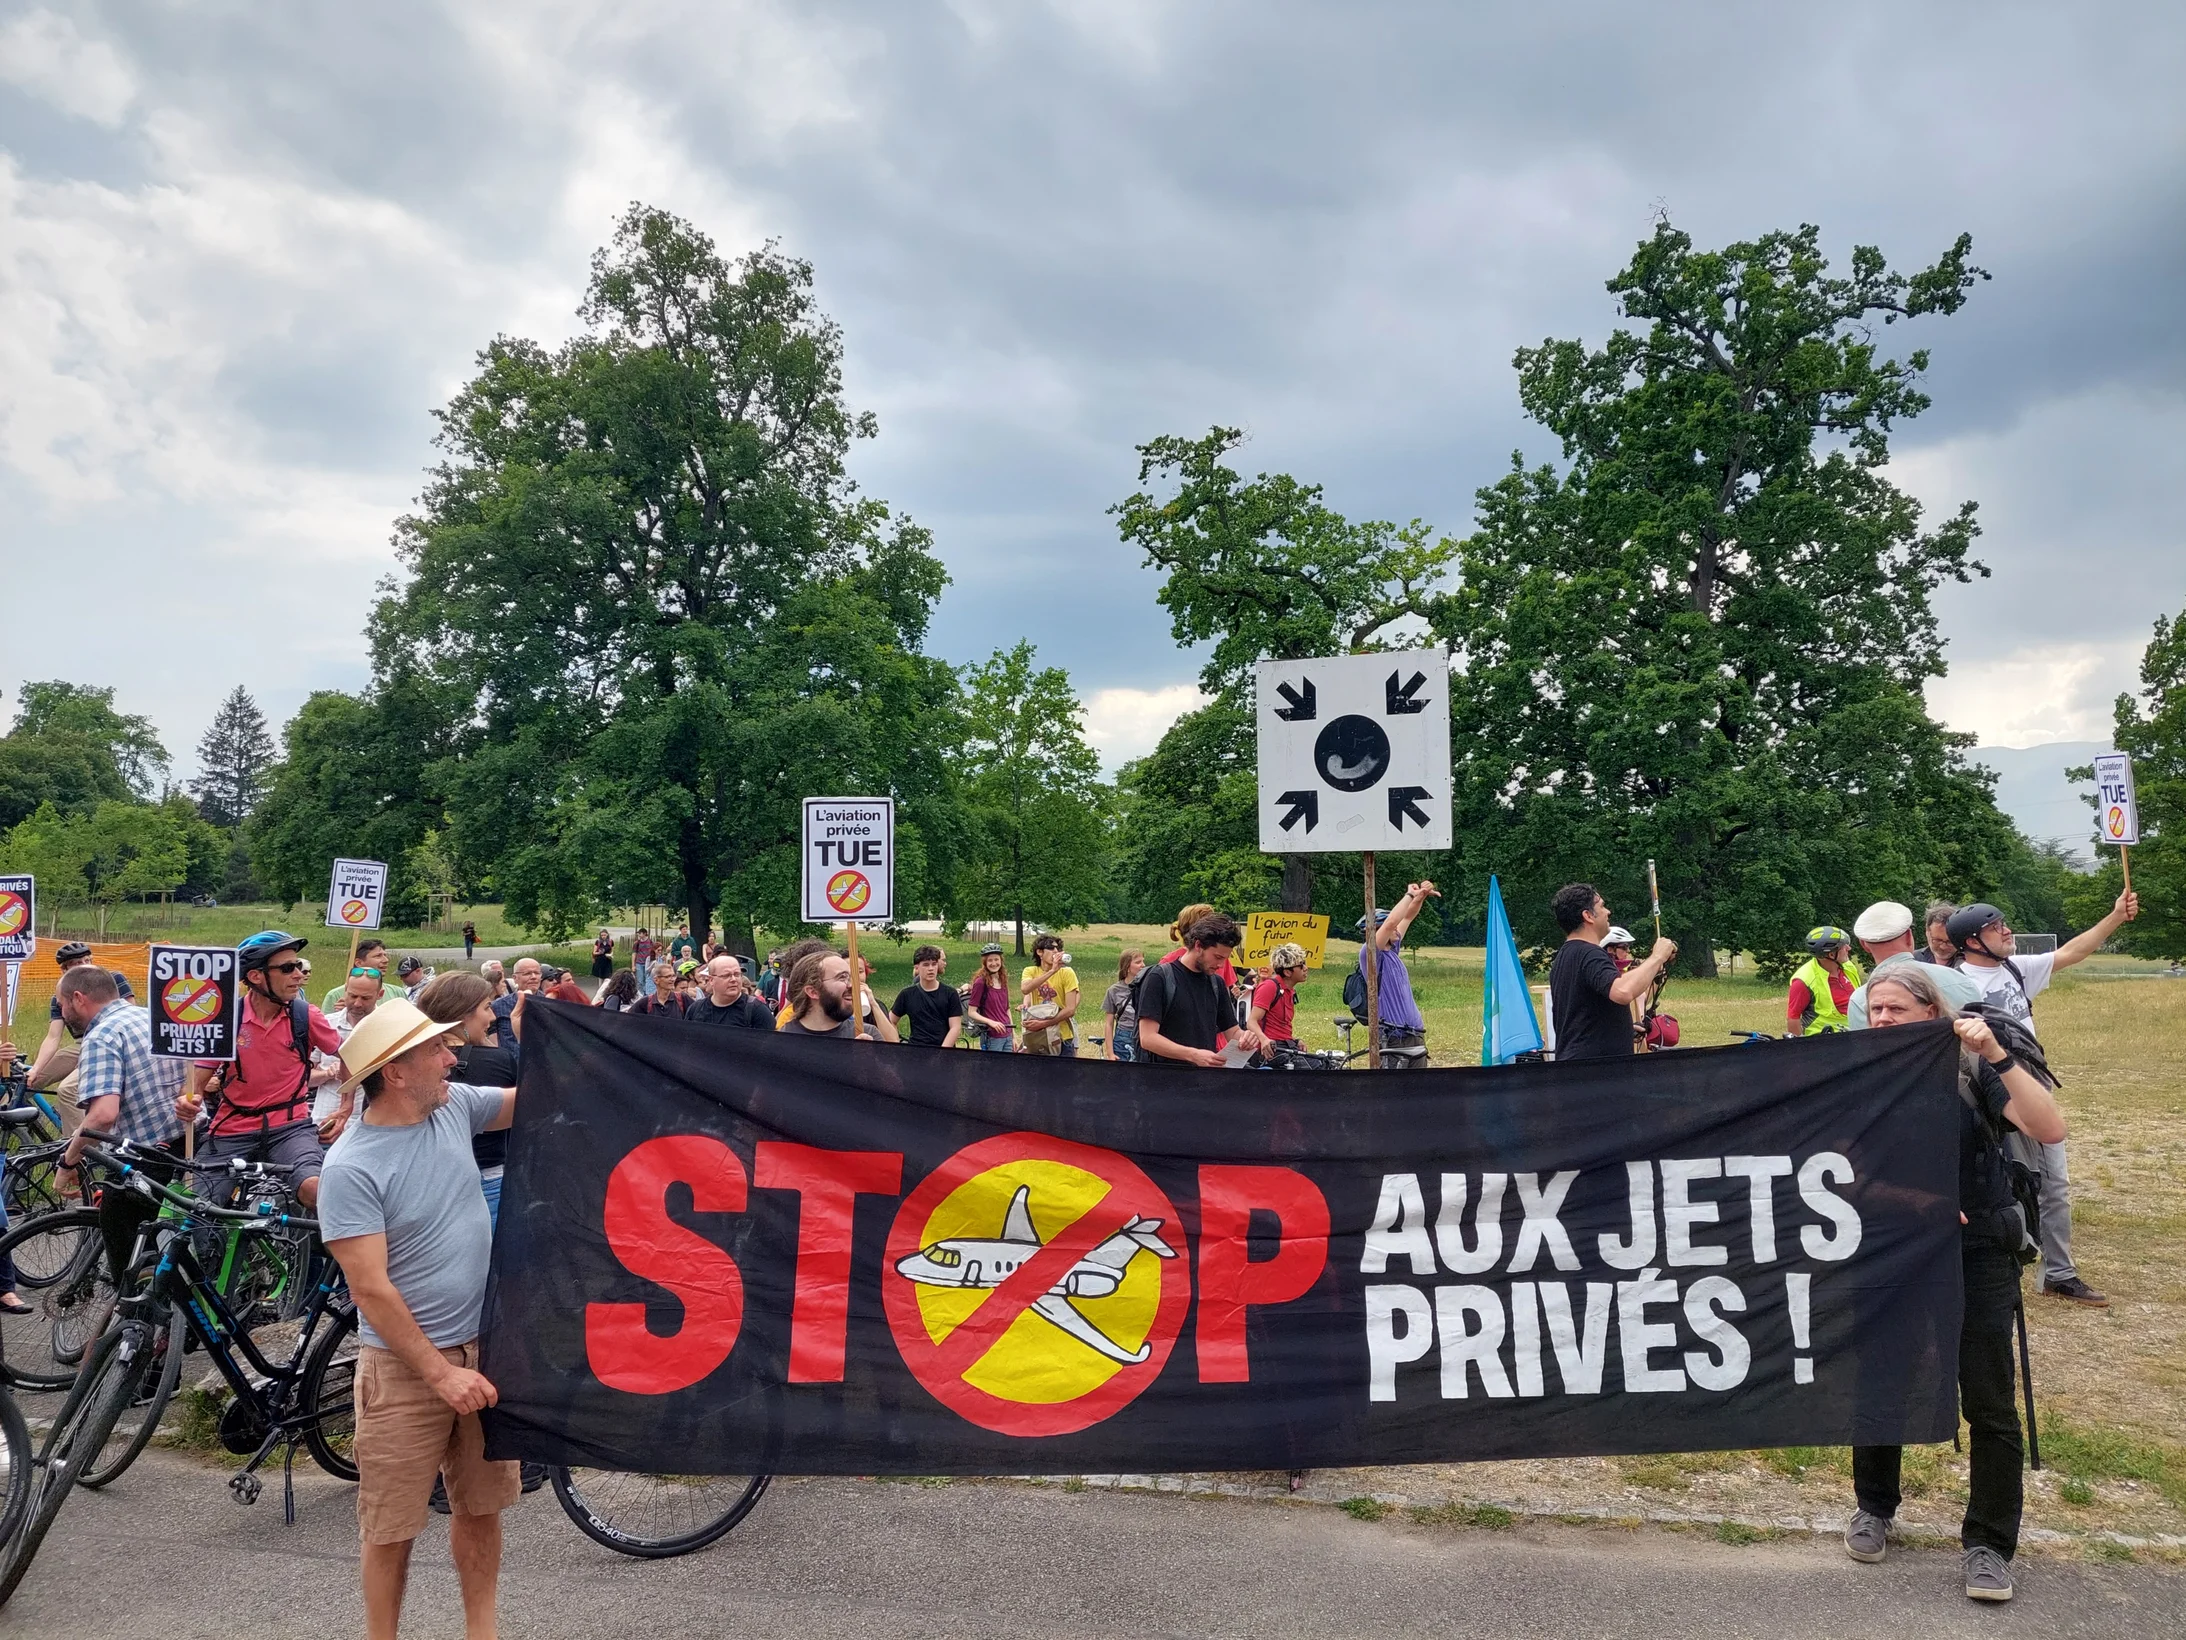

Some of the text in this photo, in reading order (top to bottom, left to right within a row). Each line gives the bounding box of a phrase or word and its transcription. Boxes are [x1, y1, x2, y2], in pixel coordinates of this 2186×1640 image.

[2099, 762, 2122, 771] L'aviation
[2104, 772, 2120, 782] privée
[2101, 784, 2127, 803] TUE
[816, 810, 880, 821] L'aviation
[827, 824, 870, 838] privée
[814, 840, 882, 866] TUE
[341, 866, 379, 875] L'aviation
[0, 880, 28, 891] RIVÉS
[338, 883, 378, 899] TUE
[1254, 915, 1317, 930] L'avion du
[155, 952, 232, 980] STOP
[160, 1023, 223, 1039] PRIVATE
[168, 1039, 205, 1053] JETS
[1360, 1151, 1862, 1274] AUX JETS
[1365, 1268, 1751, 1402] PRIVÉS
[0, 1455, 18, 1520] ONNECTION
